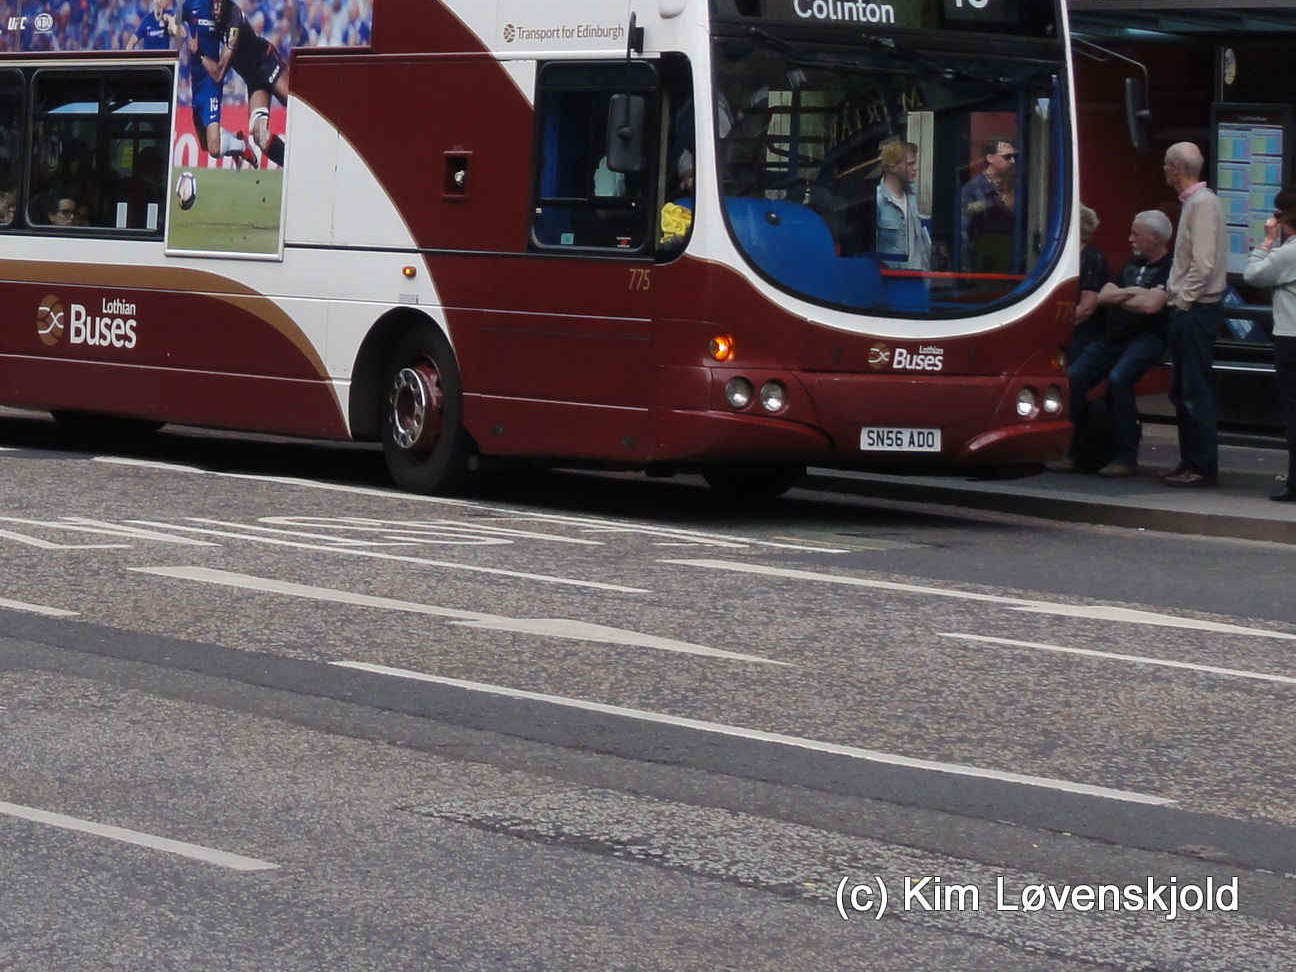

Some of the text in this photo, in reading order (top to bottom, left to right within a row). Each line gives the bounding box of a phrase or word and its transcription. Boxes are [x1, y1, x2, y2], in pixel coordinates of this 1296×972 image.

[7, 16, 28, 31] UFC
[517, 24, 625, 42] Transport for Edinburgh
[629, 268, 651, 290] 775
[102, 297, 136, 316] Lothian
[69, 303, 137, 349] Buses
[892, 348, 944, 371] Buses
[919, 345, 944, 356] Lothian
[867, 430, 935, 449] SN56 ADO
